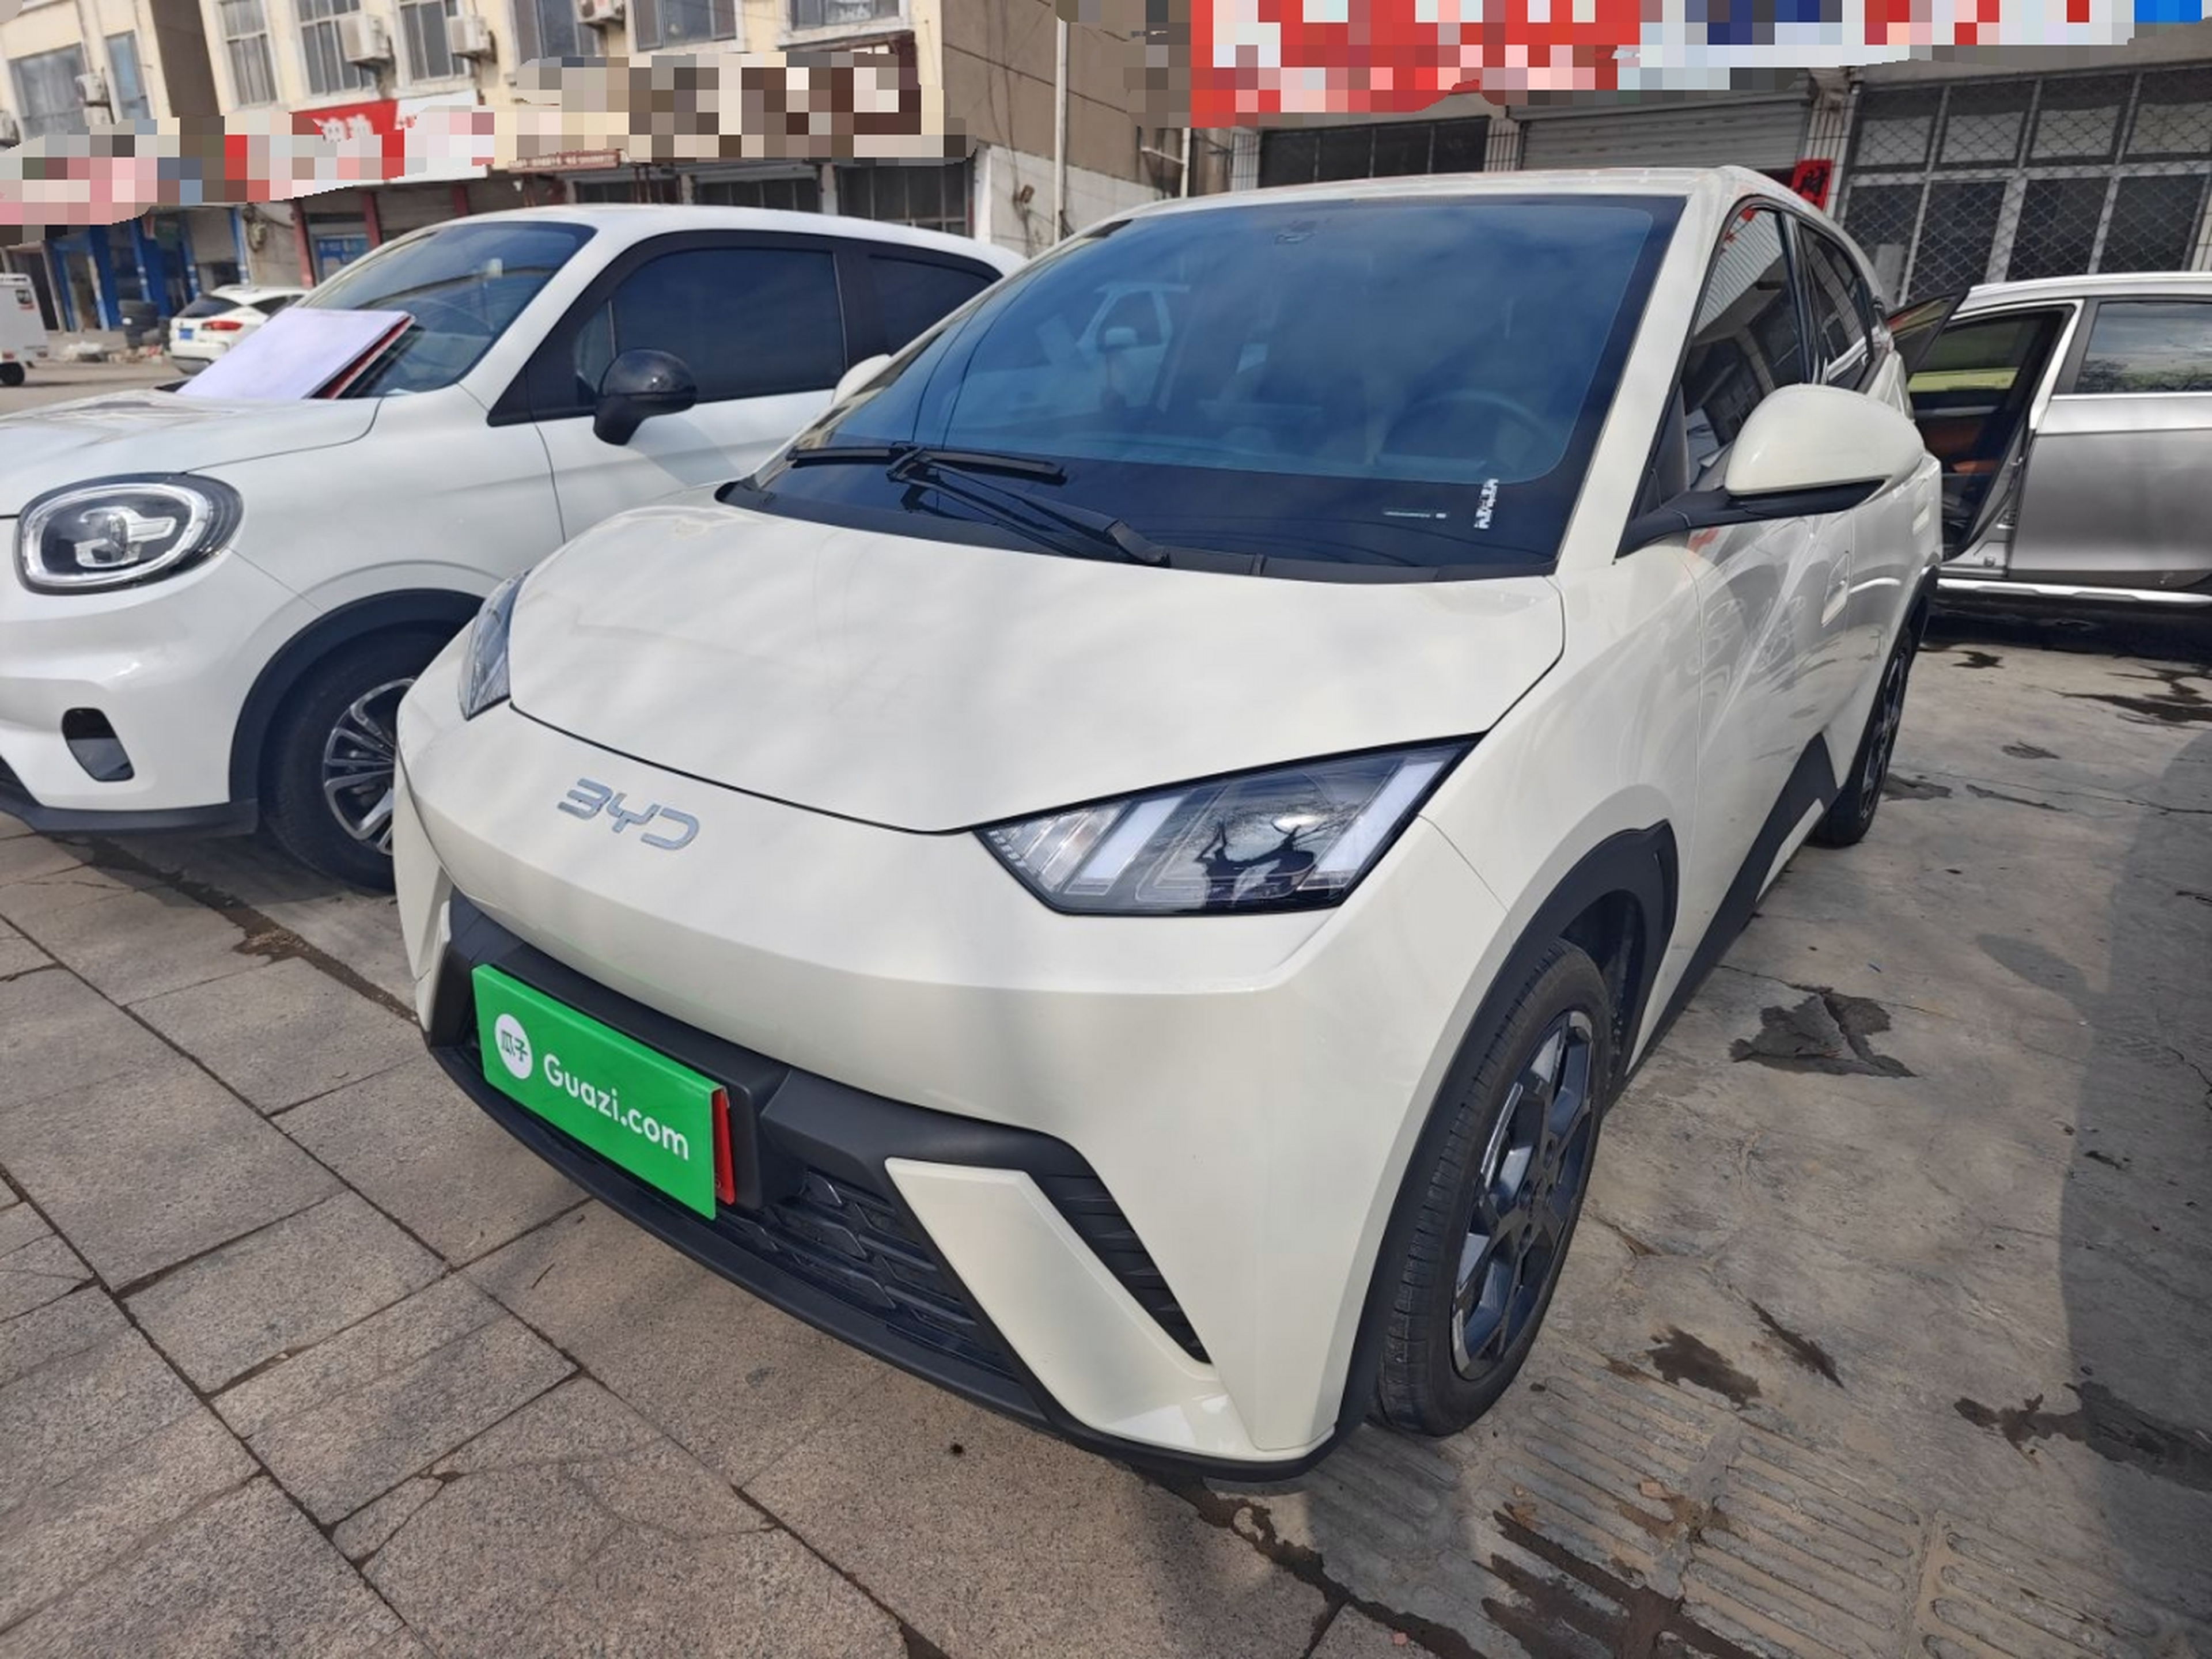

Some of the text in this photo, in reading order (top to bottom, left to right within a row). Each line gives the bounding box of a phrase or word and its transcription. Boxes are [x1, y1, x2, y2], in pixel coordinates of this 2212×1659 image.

[558, 778, 699, 850] BYD
[501, 1030, 528, 1062] 瓜子
[543, 1053, 689, 1160] Guazi.com
